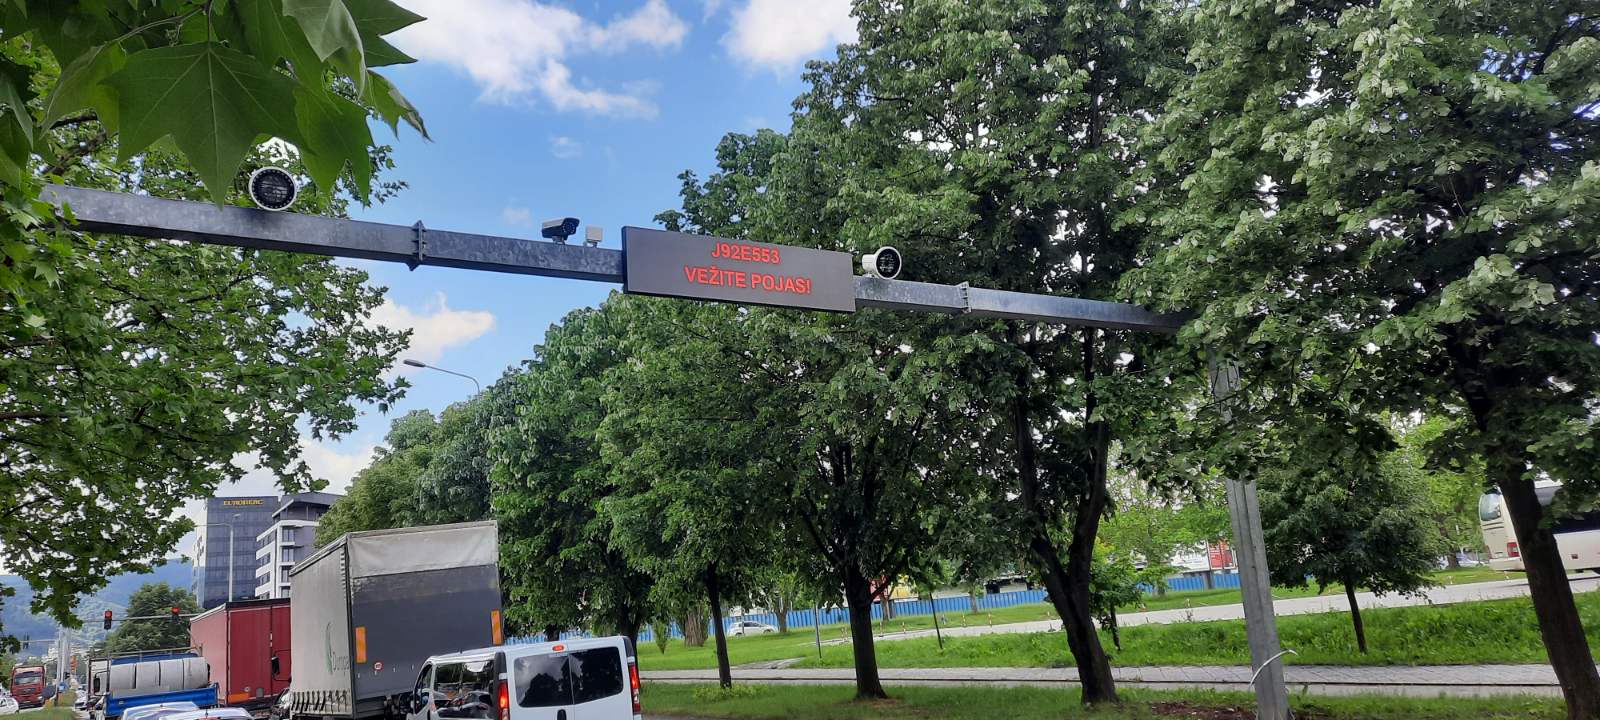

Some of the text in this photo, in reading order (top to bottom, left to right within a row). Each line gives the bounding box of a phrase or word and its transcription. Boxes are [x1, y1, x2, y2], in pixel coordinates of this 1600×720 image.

[712, 243, 780, 264] J92E553
[685, 266, 811, 293] VEŽITE POJAS!
